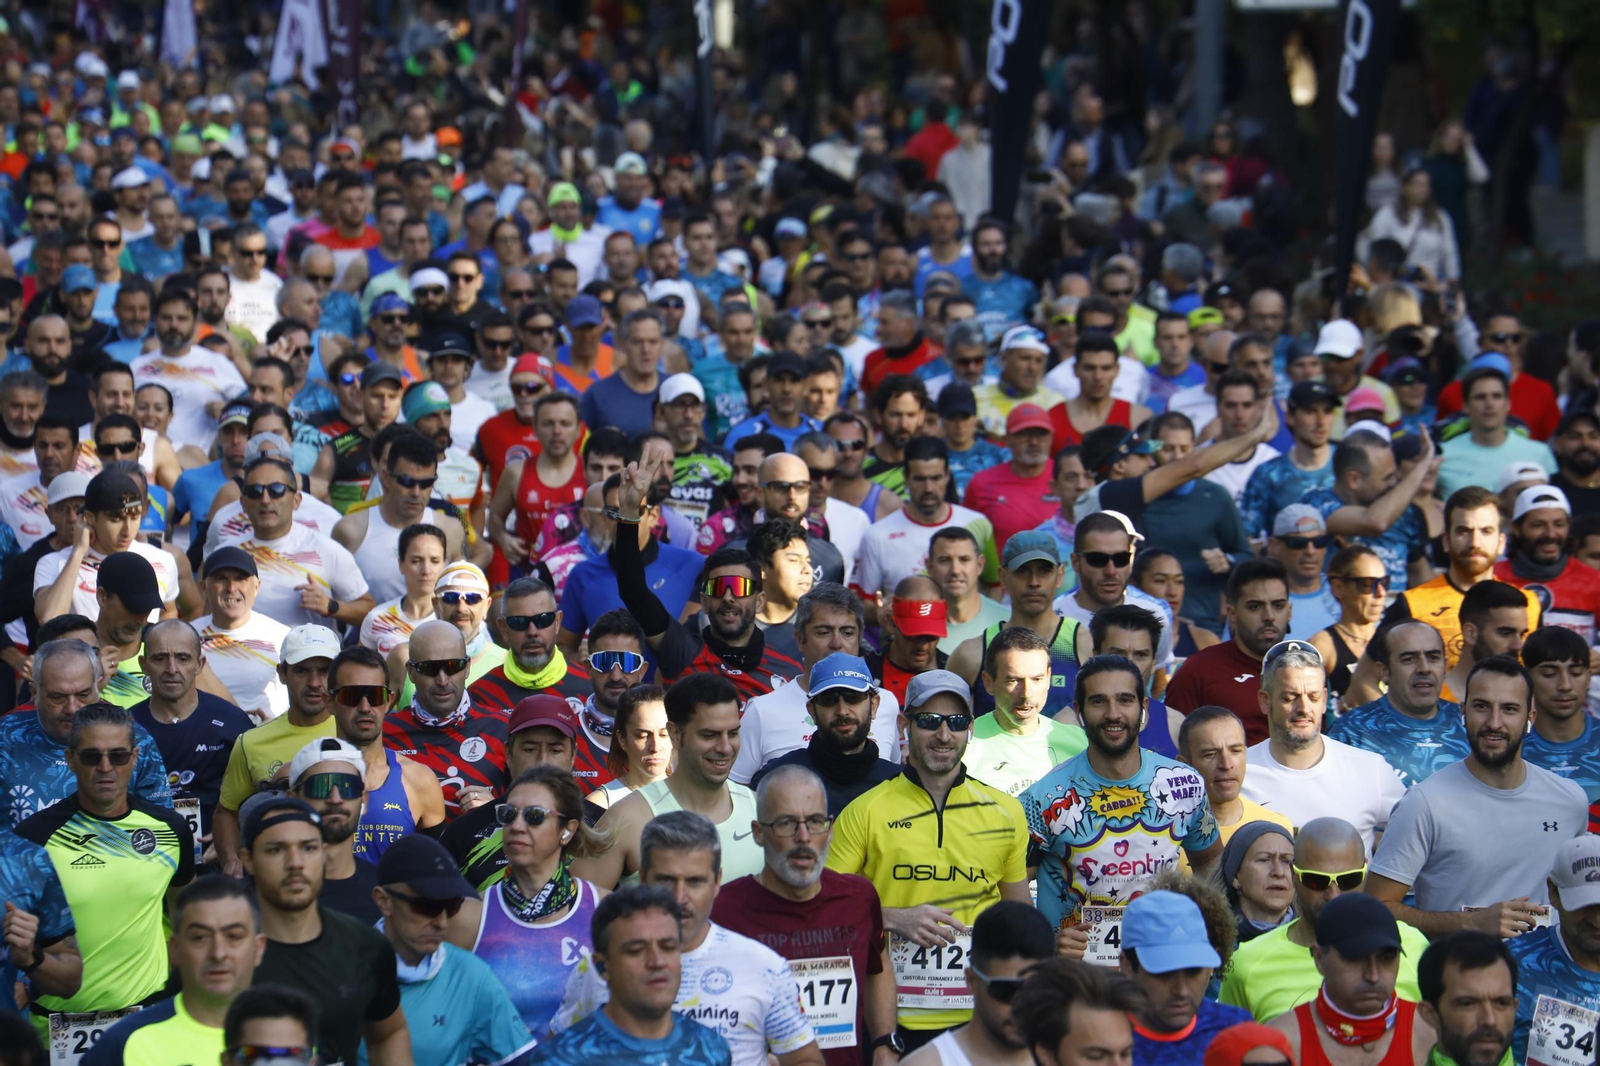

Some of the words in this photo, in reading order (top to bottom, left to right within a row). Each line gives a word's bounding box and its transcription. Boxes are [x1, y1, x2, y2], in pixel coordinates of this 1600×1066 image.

[1166, 775, 1200, 789] VENGA
[1170, 787, 1202, 801] MAE!!
[1100, 796, 1142, 813] CABRA!!
[887, 821, 913, 829] vive
[892, 864, 989, 884] OSUNA
[1084, 910, 1103, 923] 38
[757, 932, 787, 950] TOP
[1104, 925, 1121, 949] 4
[810, 960, 850, 970] MARATÓN
[1540, 1000, 1560, 1017] 38
[1555, 1023, 1595, 1057] 34
